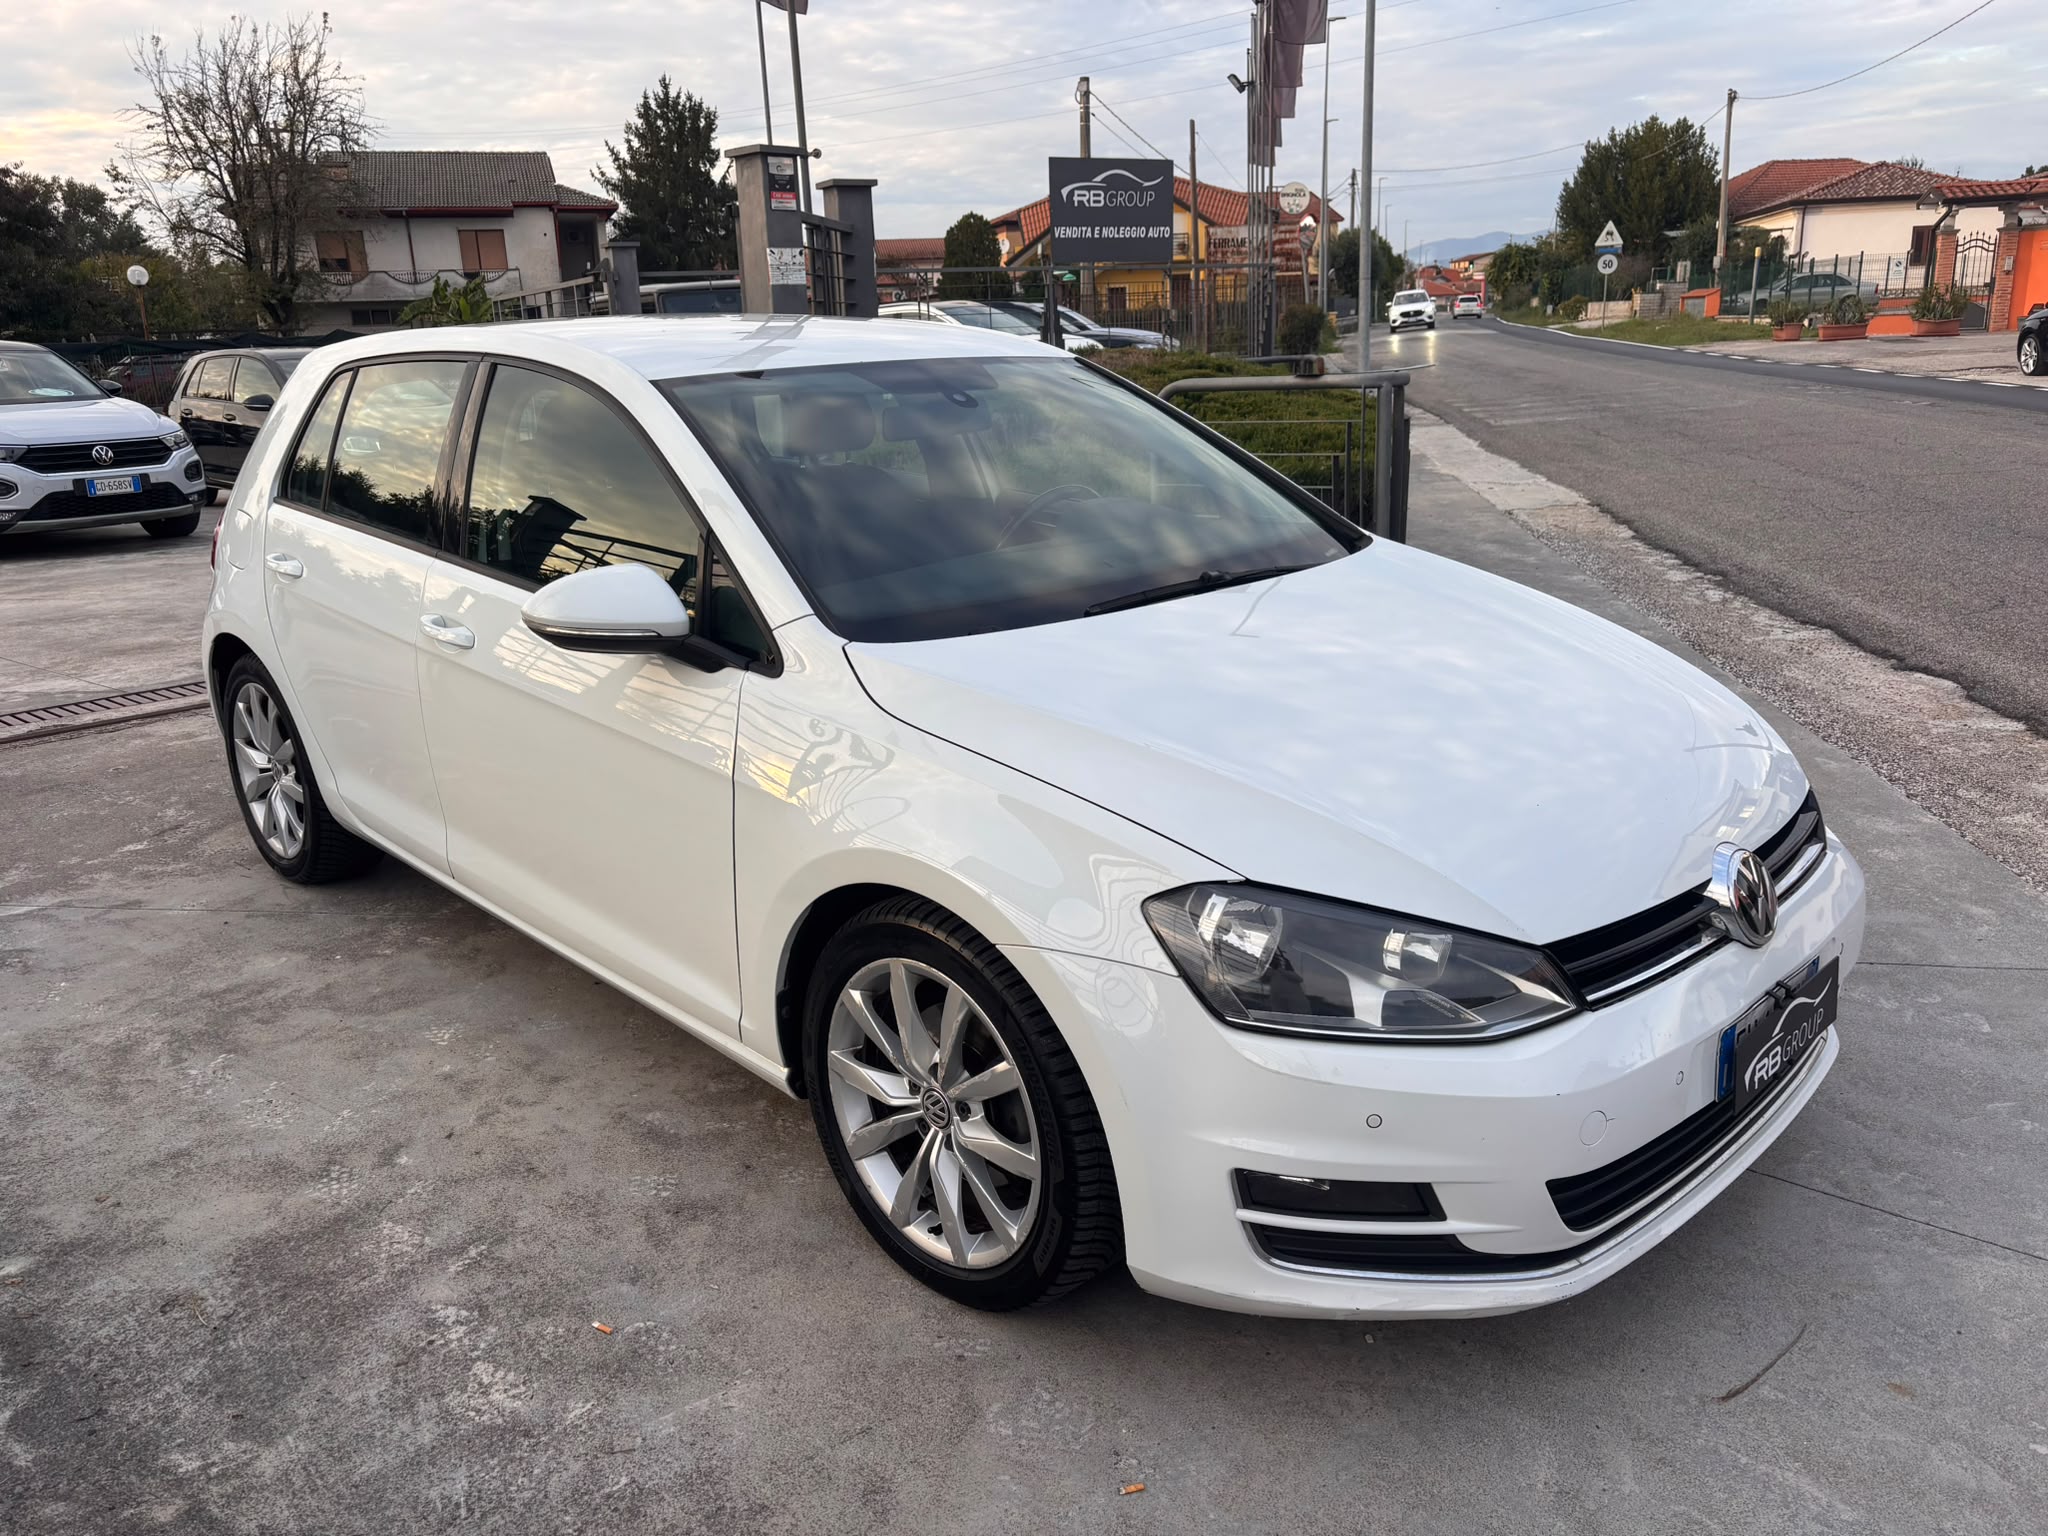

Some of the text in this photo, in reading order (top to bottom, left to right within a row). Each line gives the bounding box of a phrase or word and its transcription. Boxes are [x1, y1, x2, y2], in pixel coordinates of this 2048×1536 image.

[1054, 226, 1171, 238] VENDITA E NOLEGGIO AUTO
[1602, 259, 1613, 269] 50
